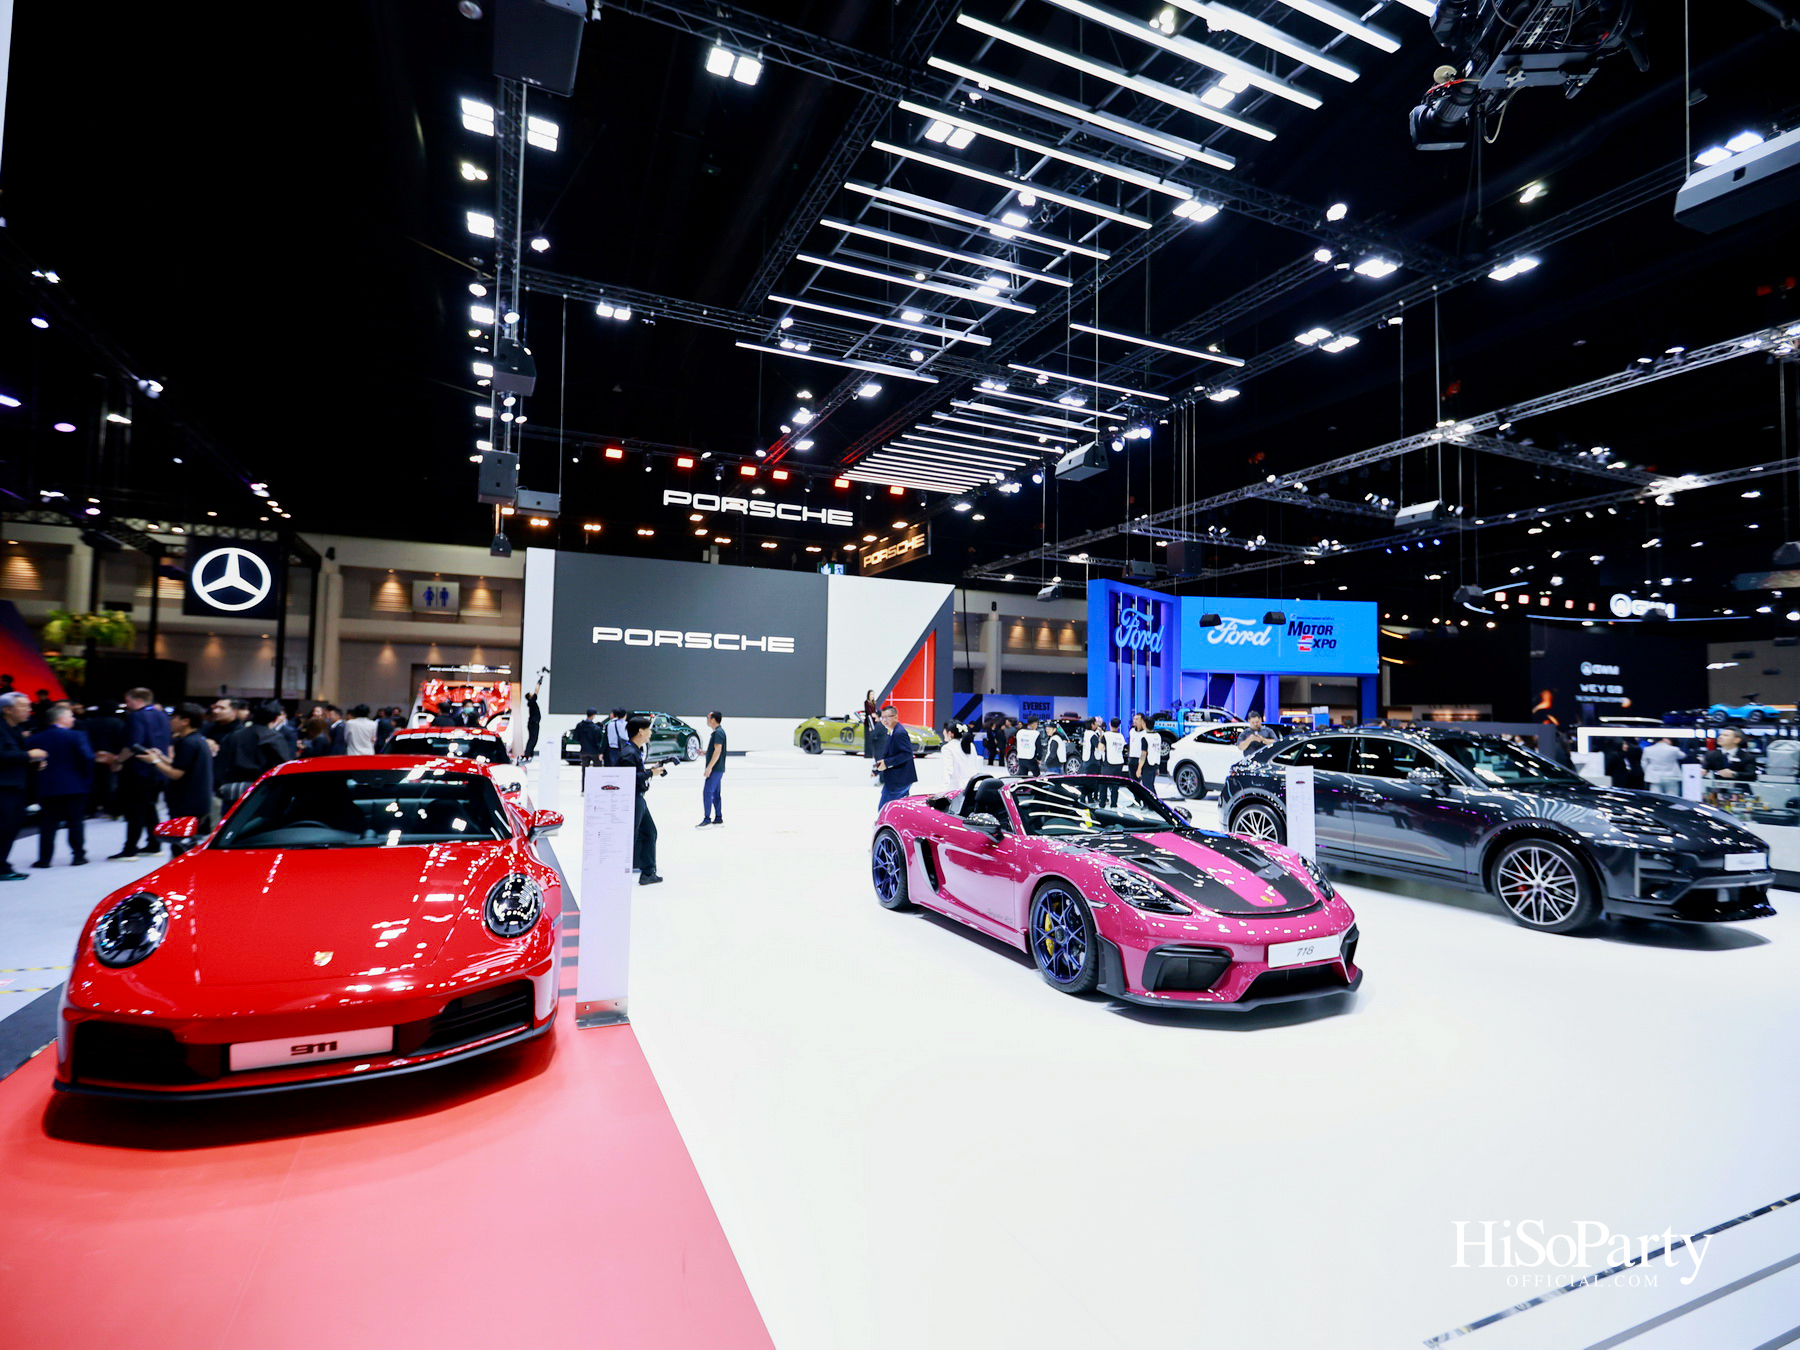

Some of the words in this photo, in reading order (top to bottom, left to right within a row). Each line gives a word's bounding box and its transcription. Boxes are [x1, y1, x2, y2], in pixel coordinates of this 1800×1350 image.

[663, 489, 853, 527] PORSCHE
[863, 533, 926, 568] PORSCHE
[1115, 608, 1165, 653] Ford
[1207, 617, 1273, 646] Ford
[1287, 621, 1334, 636] MOTOR
[592, 626, 795, 653] PORSCHE
[1297, 635, 1337, 651] EXPO
[1022, 701, 1051, 711] EVEREST
[841, 730, 854, 743] 70
[1297, 946, 1315, 957] 718
[290, 1041, 338, 1056] 911
